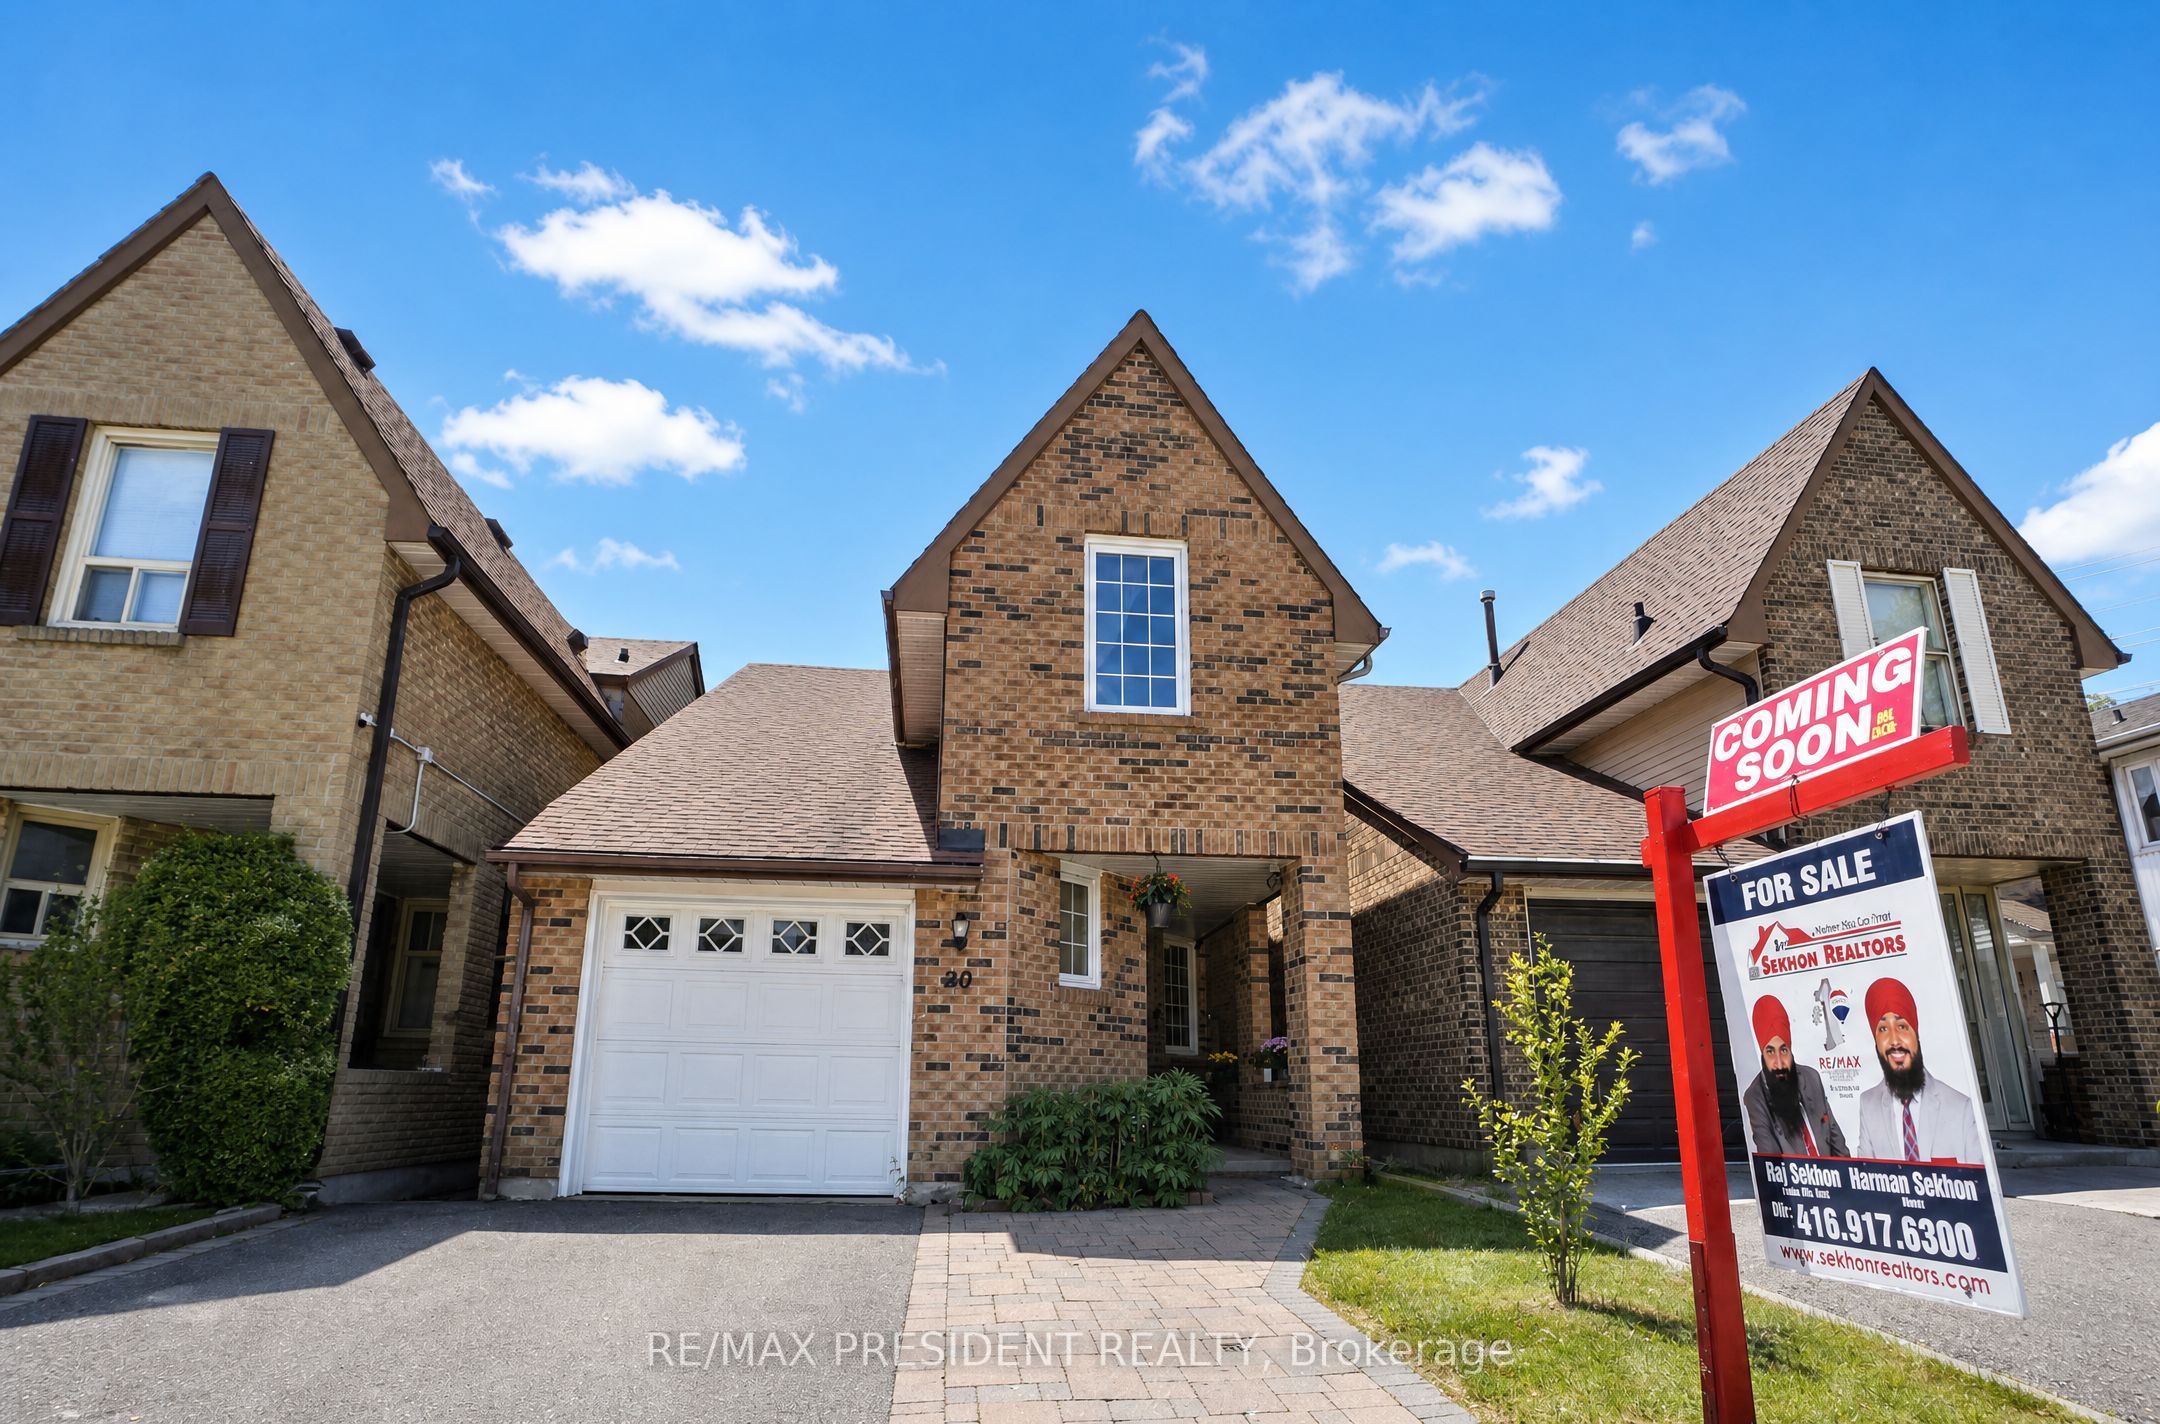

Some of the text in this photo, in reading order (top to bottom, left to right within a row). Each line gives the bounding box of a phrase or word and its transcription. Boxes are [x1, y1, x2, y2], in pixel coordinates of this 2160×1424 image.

[1713, 646, 1912, 762] COMING
[1735, 703, 1872, 792] SOON
[1741, 848, 1876, 911] FOR SALE
[1761, 951, 1818, 975] SEKHON
[1824, 934, 1906, 964] REALTORS
[1819, 1055, 1861, 1069] RE/MAX
[1765, 1161, 1788, 1186] Raj
[1791, 1162, 1842, 1188] Sekhon
[1848, 1166, 1909, 1194] Harman
[1912, 1171, 1978, 1201] Sekhon
[1796, 1203, 1978, 1261] 416.917.6300
[1780, 1243, 1991, 1295] www.sekhonrealtors.com
